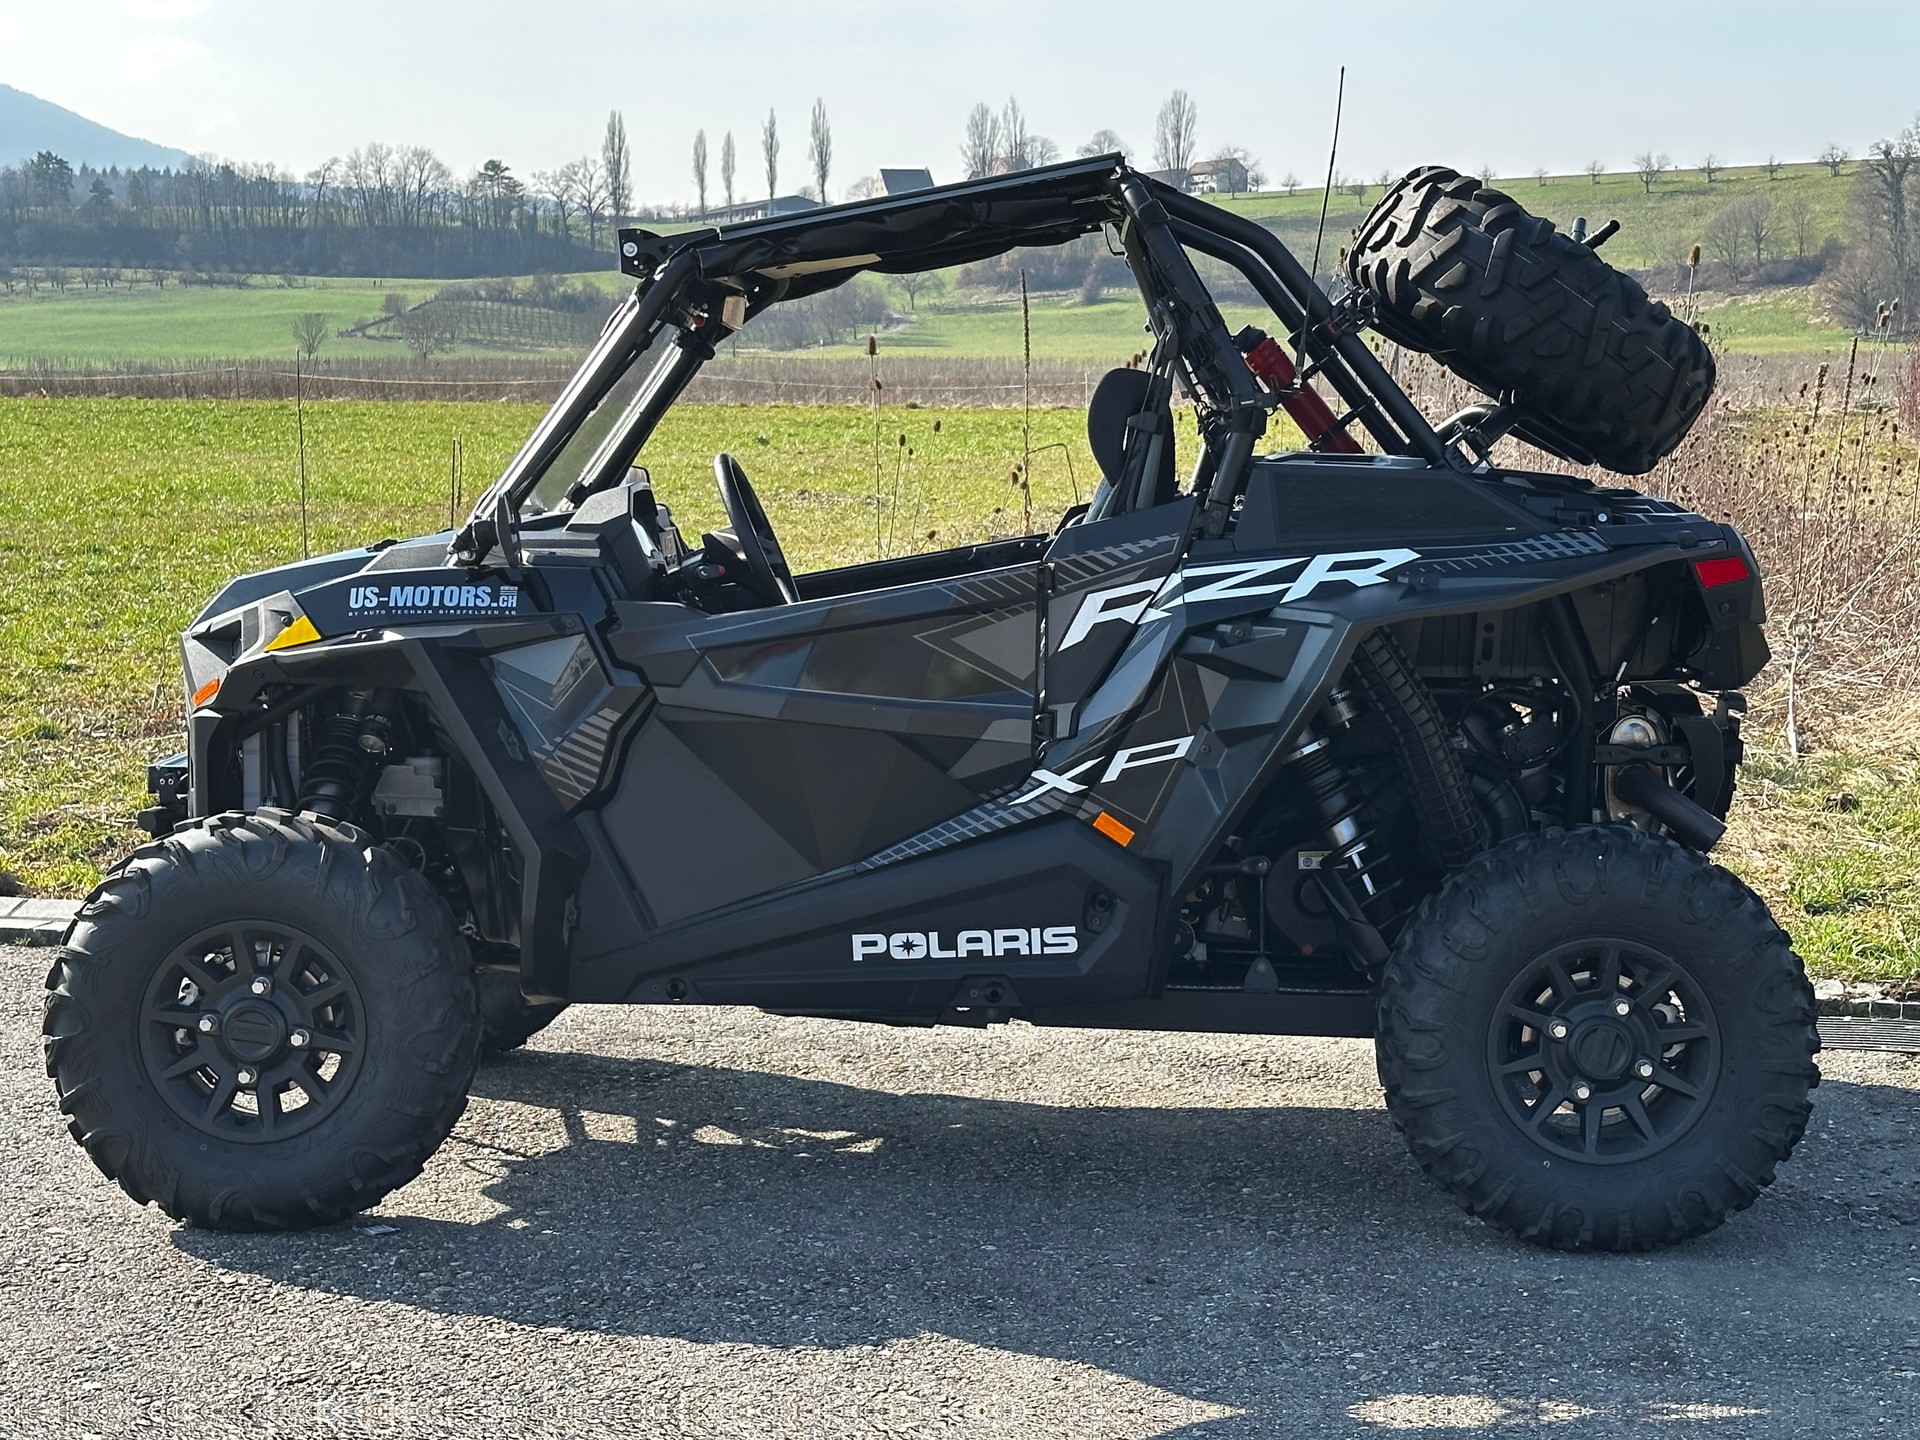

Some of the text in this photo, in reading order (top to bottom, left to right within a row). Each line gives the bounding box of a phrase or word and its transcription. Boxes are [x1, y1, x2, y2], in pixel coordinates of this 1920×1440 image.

[1058, 548, 1422, 652] RZR
[1008, 735, 1195, 805] XP
[852, 926, 1078, 961] POLARIS
